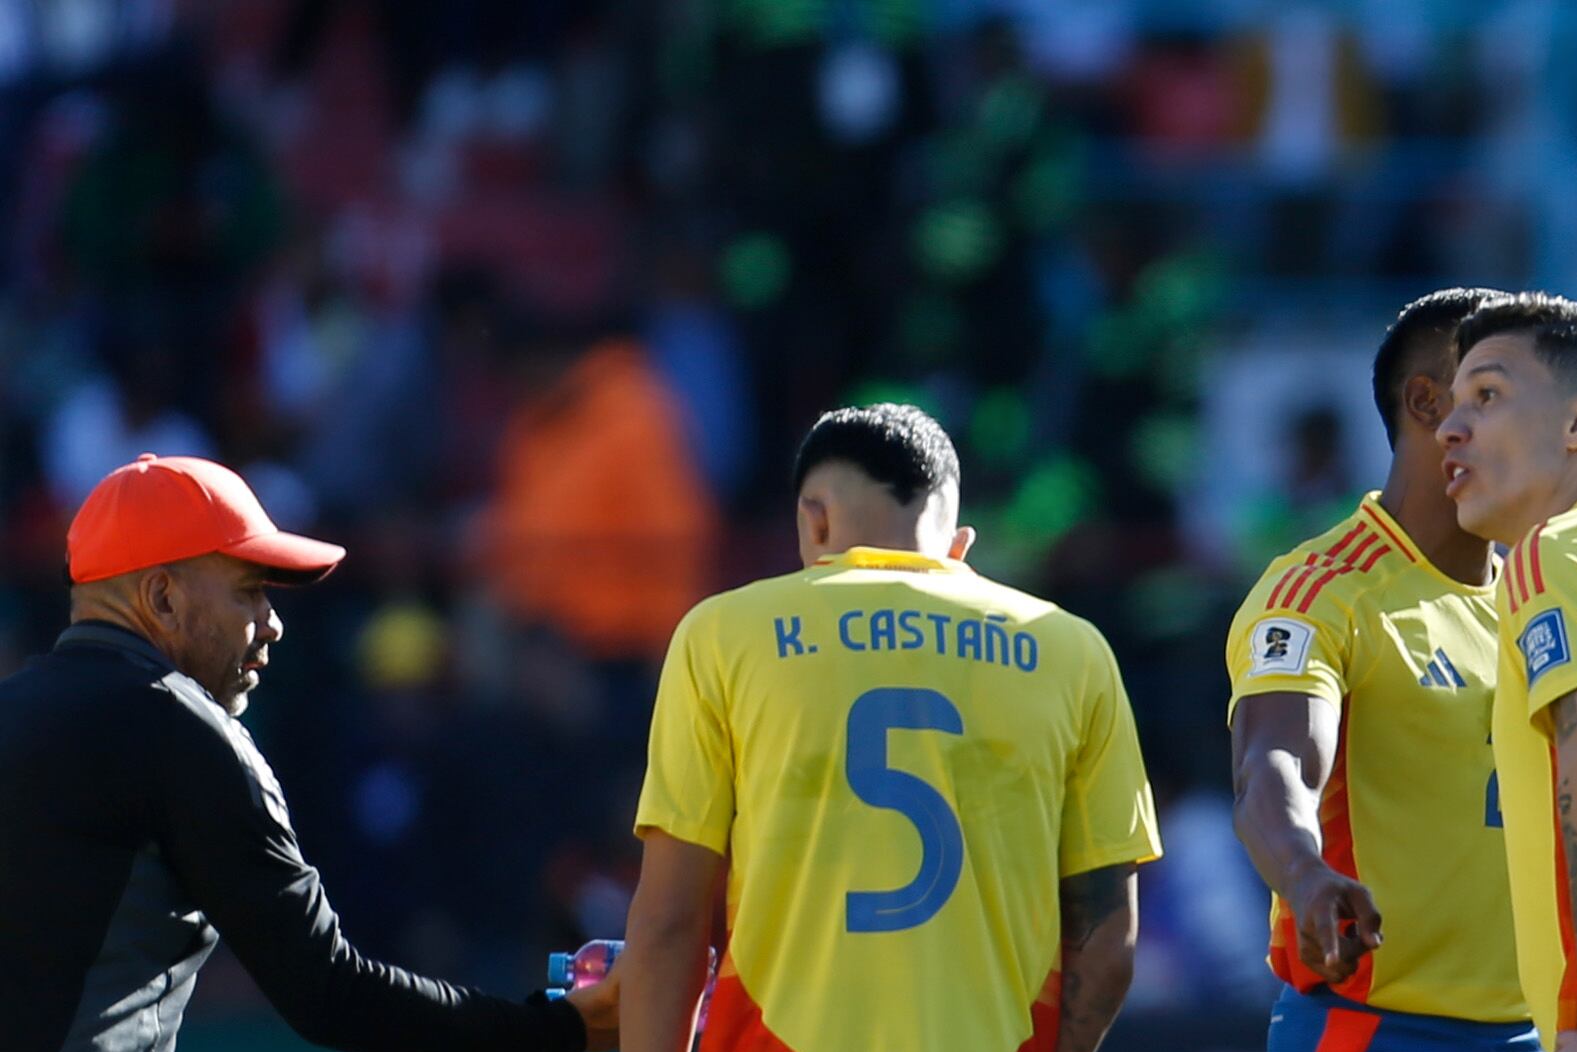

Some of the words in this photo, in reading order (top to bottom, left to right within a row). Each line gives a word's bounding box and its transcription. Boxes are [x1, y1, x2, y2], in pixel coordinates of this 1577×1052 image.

[774, 616, 818, 658] K.
[838, 608, 1039, 673] CASTAÑO
[846, 686, 964, 933] 5
